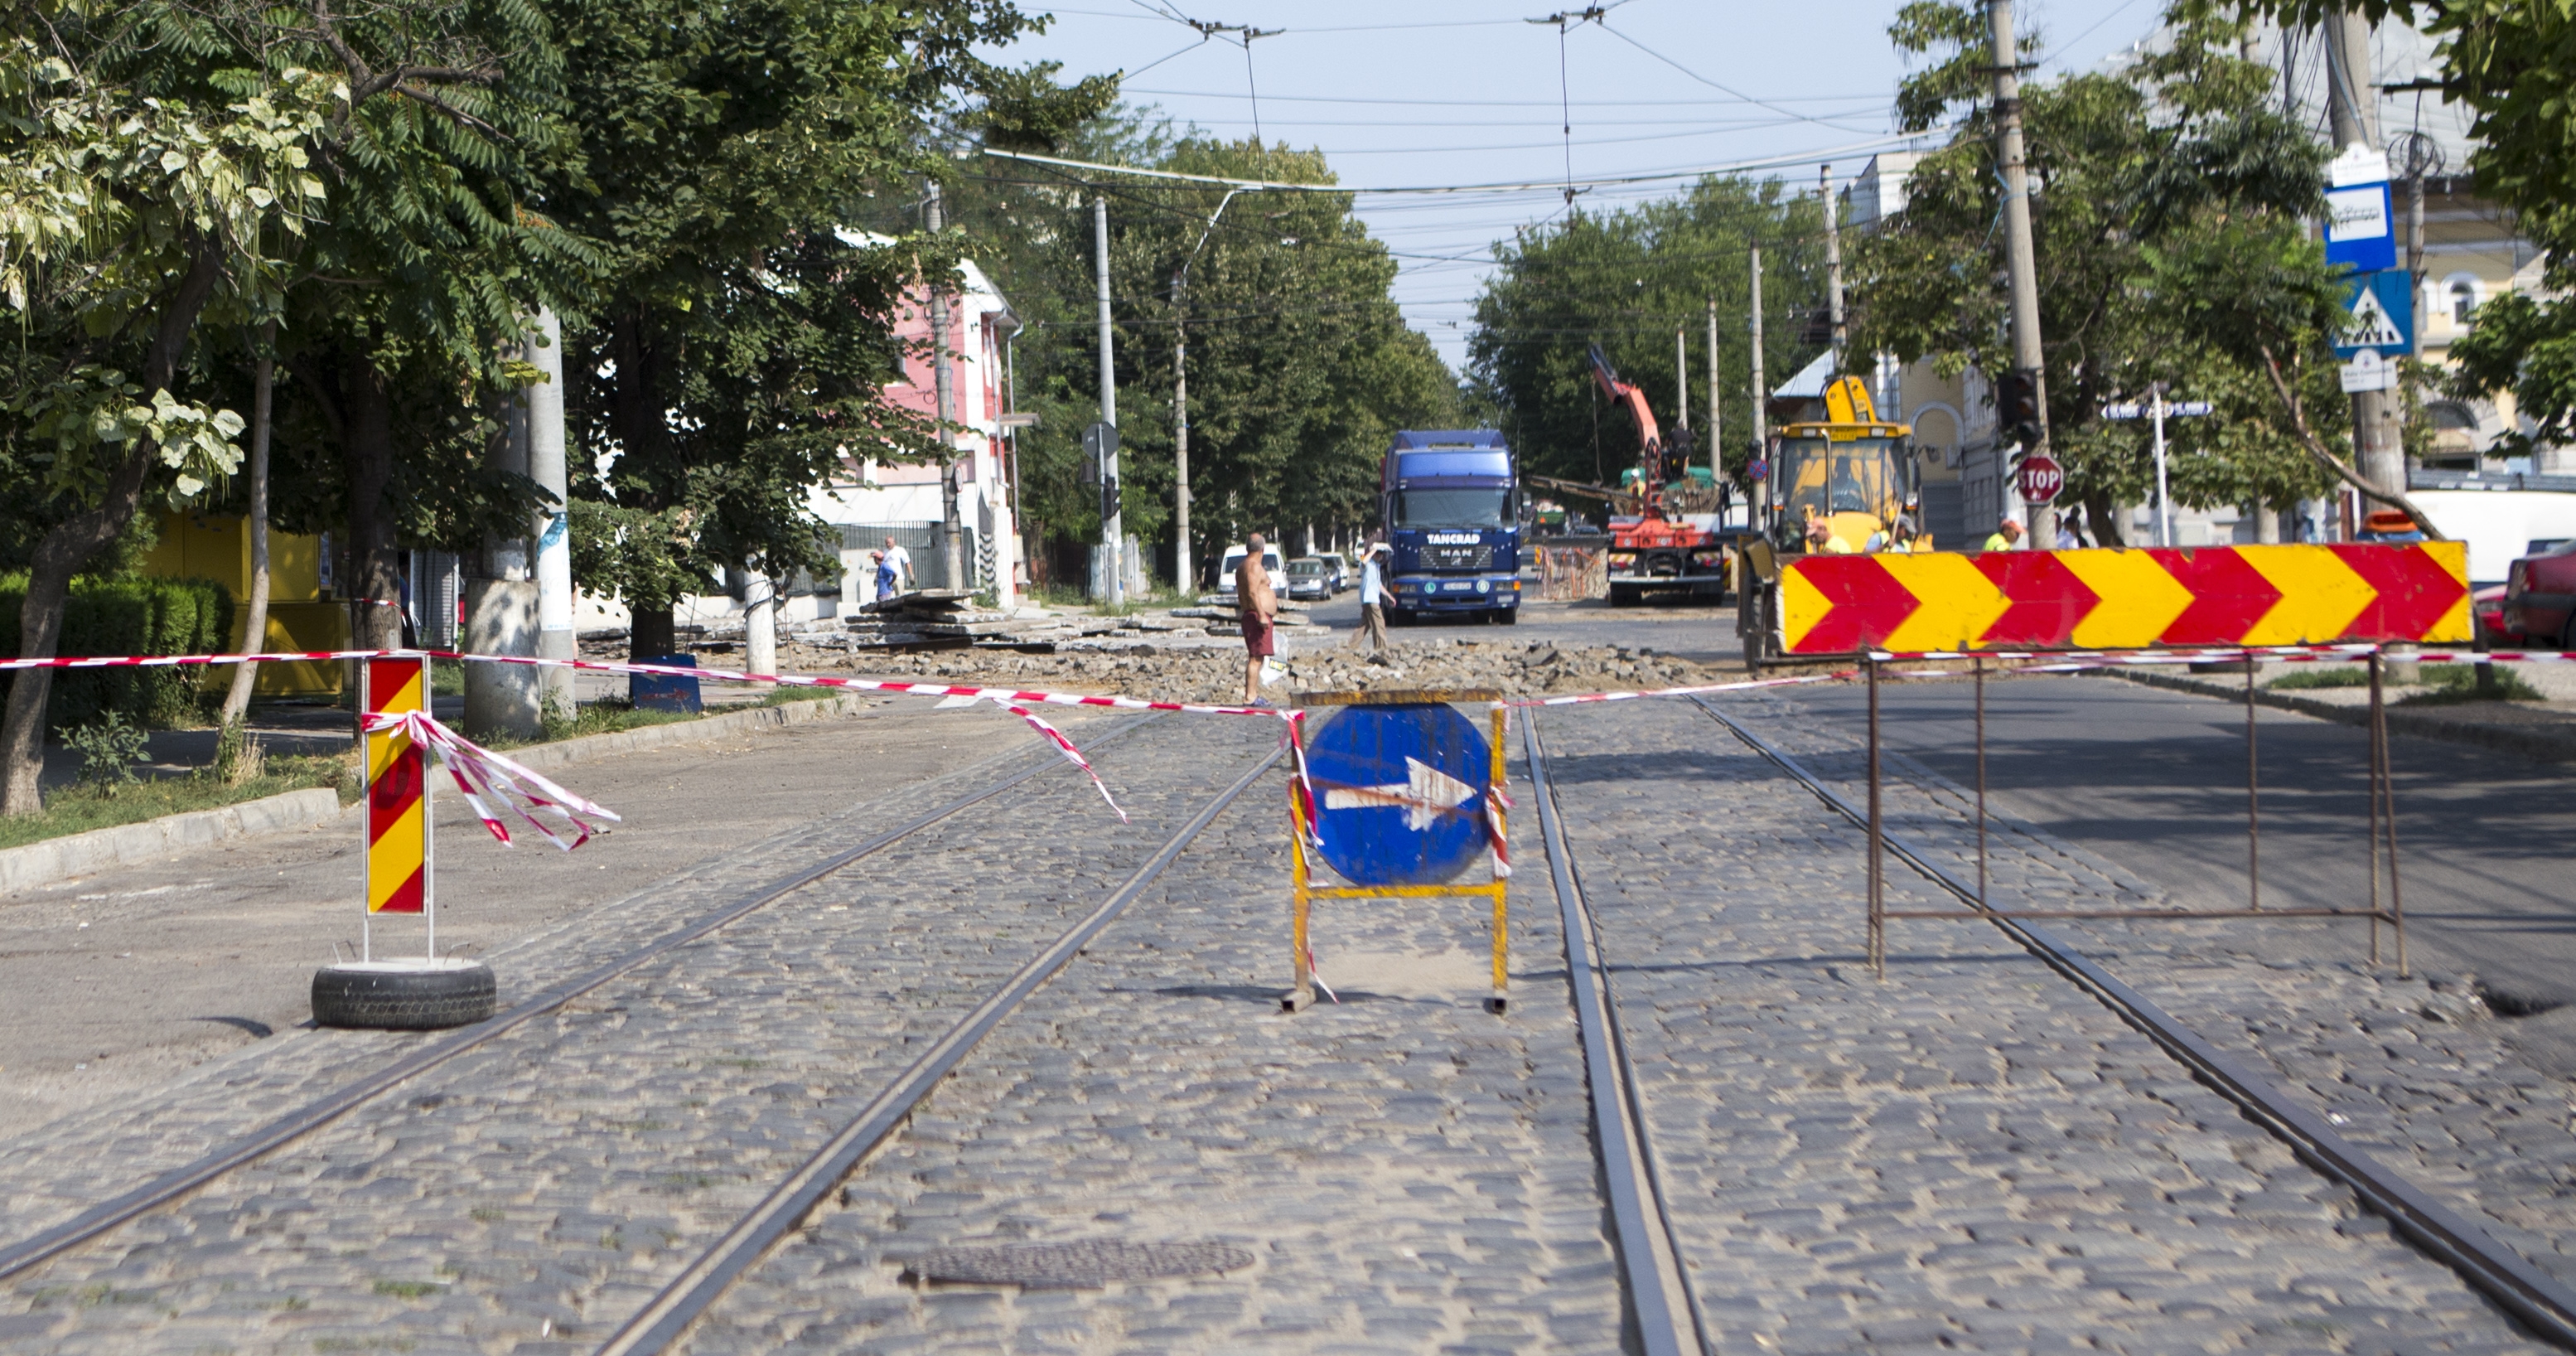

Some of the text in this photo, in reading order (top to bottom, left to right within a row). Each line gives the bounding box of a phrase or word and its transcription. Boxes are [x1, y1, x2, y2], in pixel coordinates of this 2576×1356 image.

[2018, 469, 2060, 490] STOP
[1427, 534, 1481, 545] TANCRAD
[1440, 549, 1472, 557] MAN
